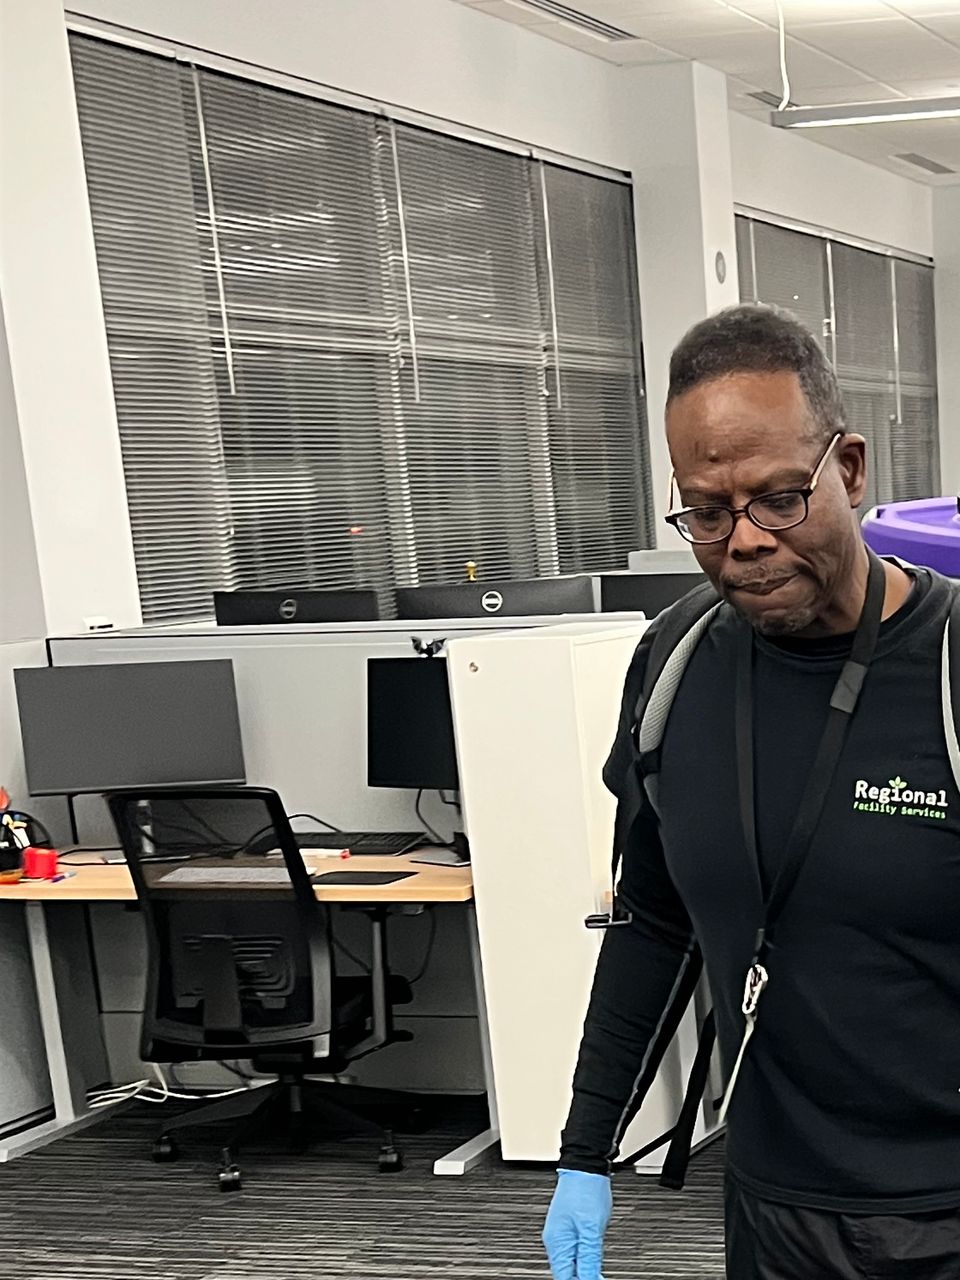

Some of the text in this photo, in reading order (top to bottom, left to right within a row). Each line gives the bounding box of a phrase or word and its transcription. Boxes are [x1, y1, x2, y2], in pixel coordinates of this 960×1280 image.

[855, 779, 949, 807] Regional
[853, 801, 946, 819] Facility Services
